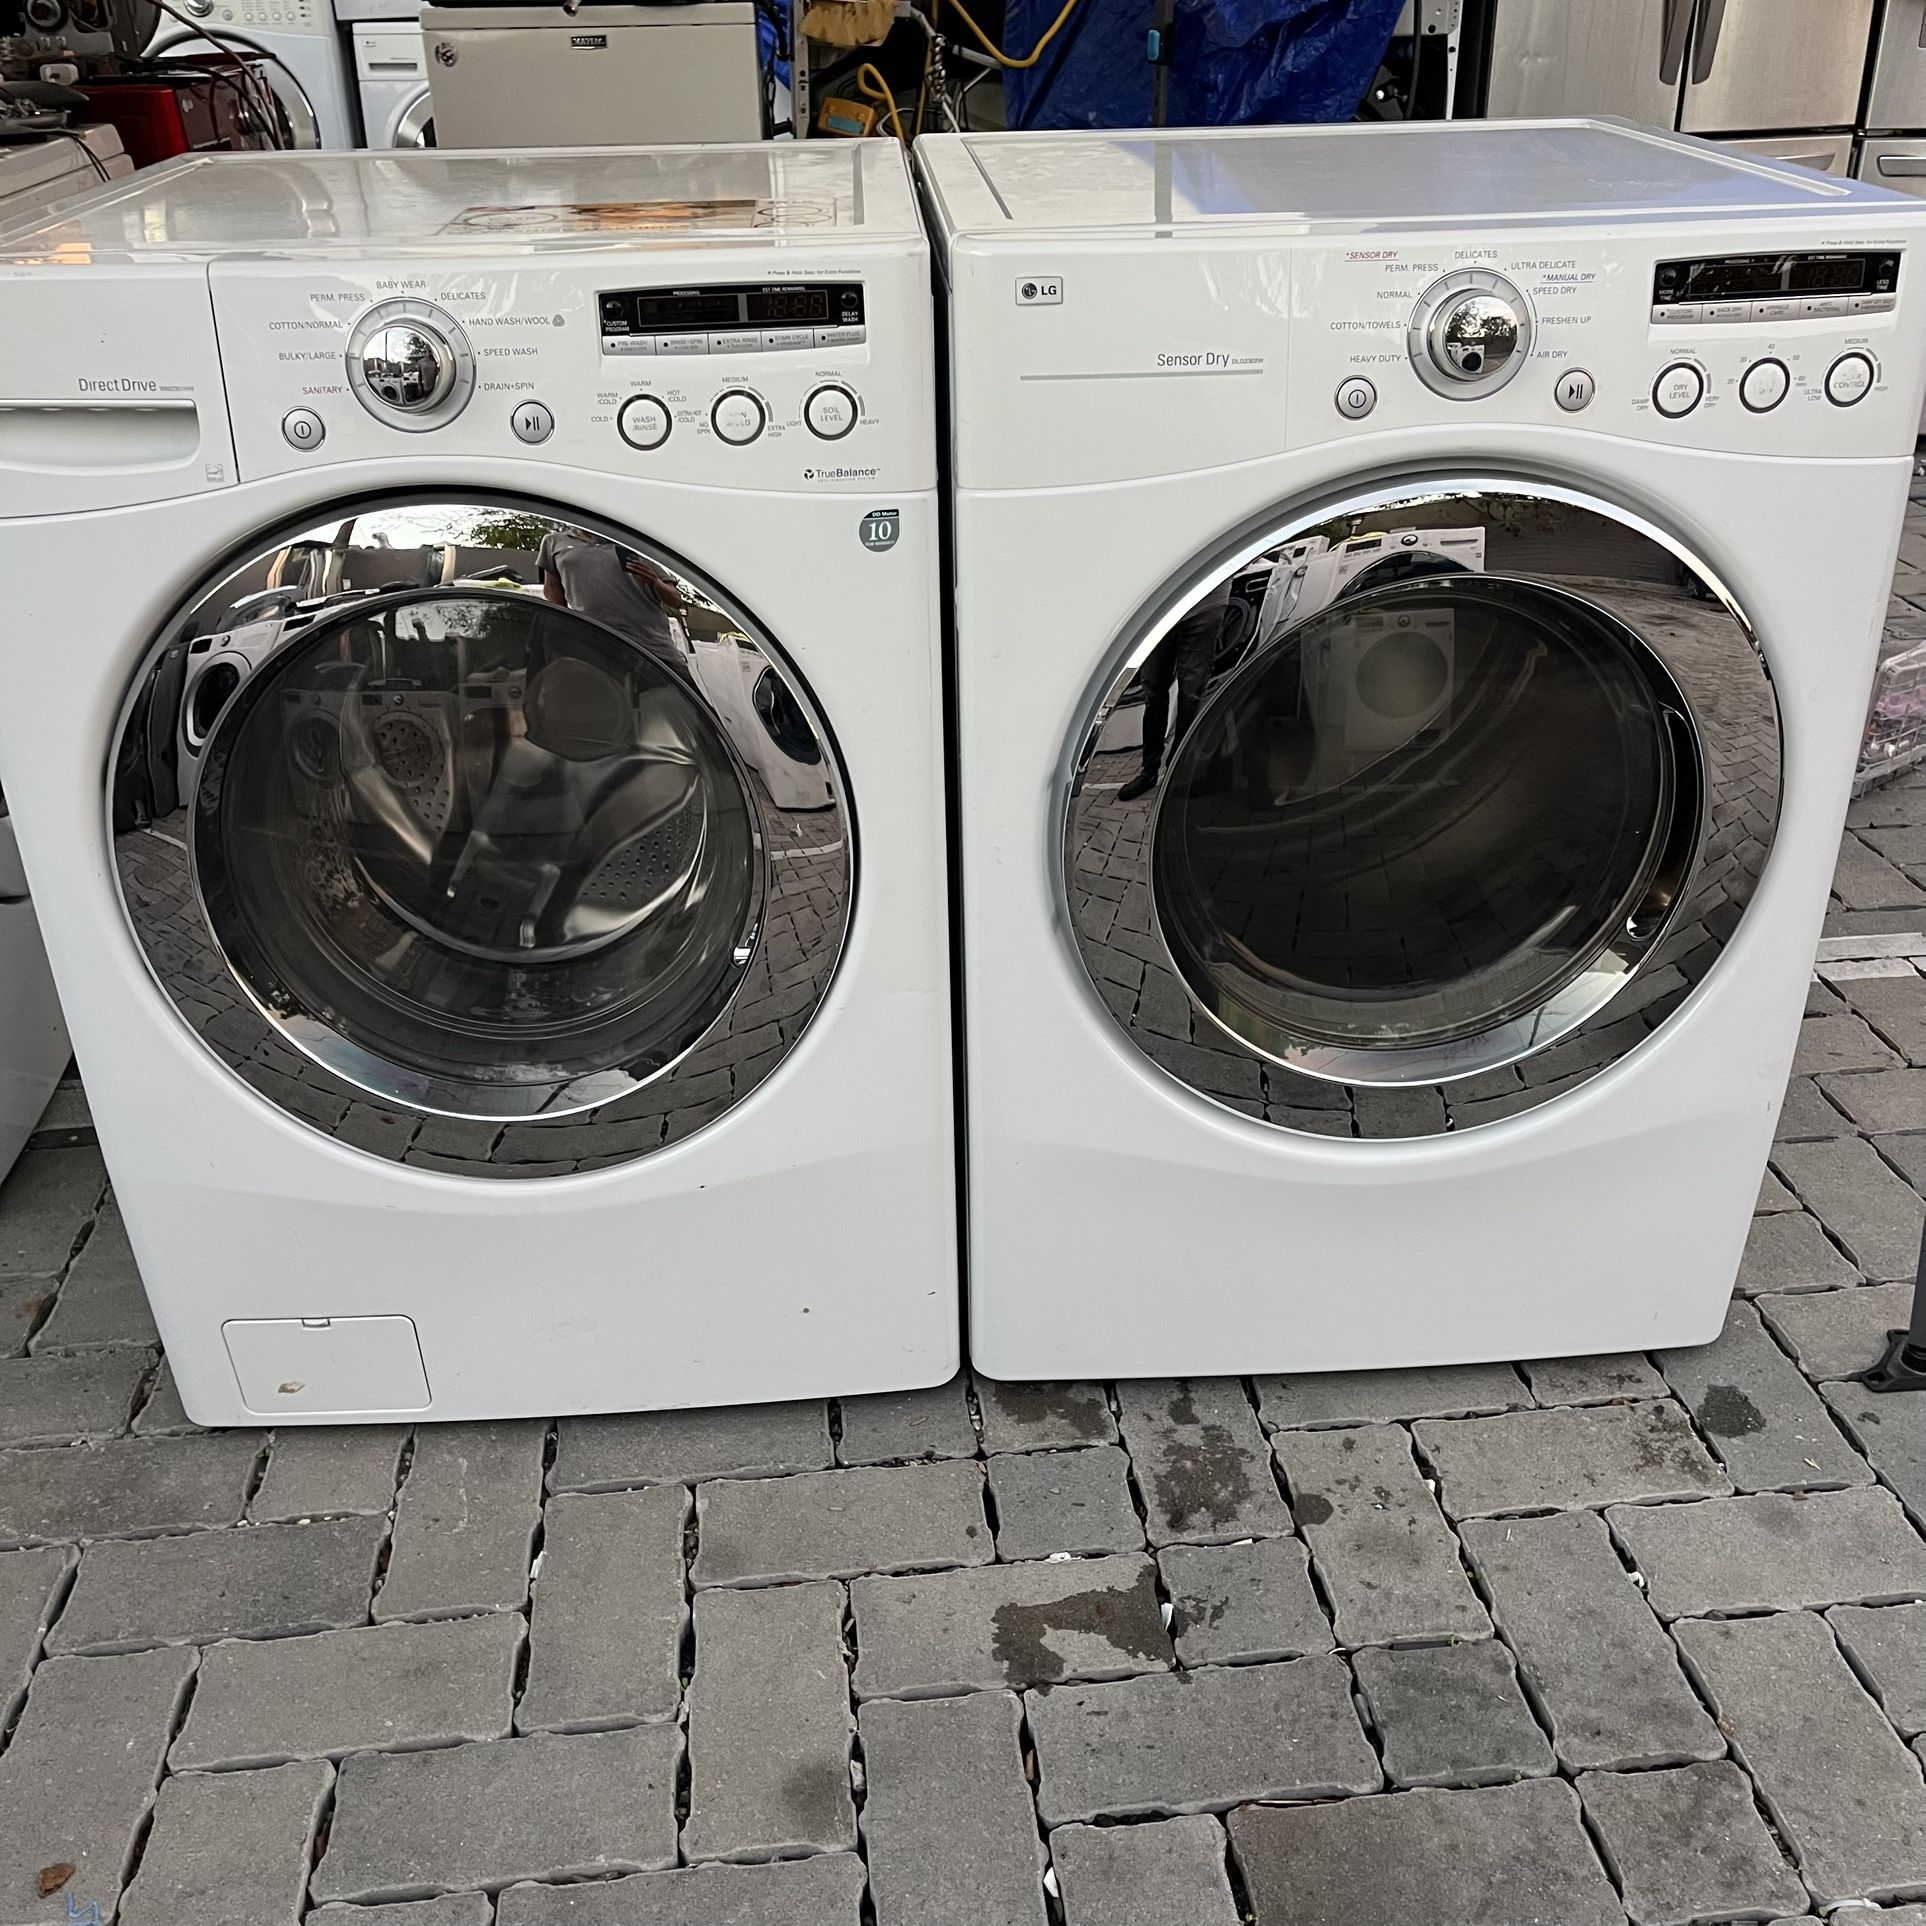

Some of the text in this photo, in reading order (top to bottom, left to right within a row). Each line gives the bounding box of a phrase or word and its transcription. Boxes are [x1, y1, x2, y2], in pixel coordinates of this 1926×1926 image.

[1381, 250, 1398, 259] DRY
[1454, 250, 1498, 259] DELICATES
[1385, 263, 1439, 272] PERM. PRESS
[1510, 260, 1576, 270] ULTRA DELICATE
[1580, 273, 1596, 281] DRY
[376, 280, 427, 290] BABY WEAR
[1040, 285, 1057, 296] LG
[1376, 290, 1412, 299] NORMAL
[1532, 286, 1577, 295] SPEED DRY
[310, 292, 366, 302] PERM. PRESS
[440, 291, 486, 301] DELICATES
[468, 316, 551, 326] HAND WASH/WOOL
[1541, 315, 1592, 325] FRESHEN UP
[269, 320, 343, 330] COTTON/NORMAL
[1330, 321, 1401, 330] COTTON/TOWELS
[278, 351, 337, 361] BULKY/LARGE
[483, 347, 538, 357] SPEED WASH
[1536, 350, 1568, 359] AIR DRY
[1156, 352, 1203, 367] Sensor
[1205, 352, 1231, 368] Dry
[1349, 354, 1401, 363] HEAVY DUTY
[78, 377, 157, 392] Direct Drive
[302, 386, 343, 395] SANITARY
[1669, 391, 1690, 399] LEVEL
[822, 406, 841, 414] SOIL
[631, 416, 656, 424] WASH
[820, 413, 843, 422] LEVEL
[868, 520, 892, 541] 10
